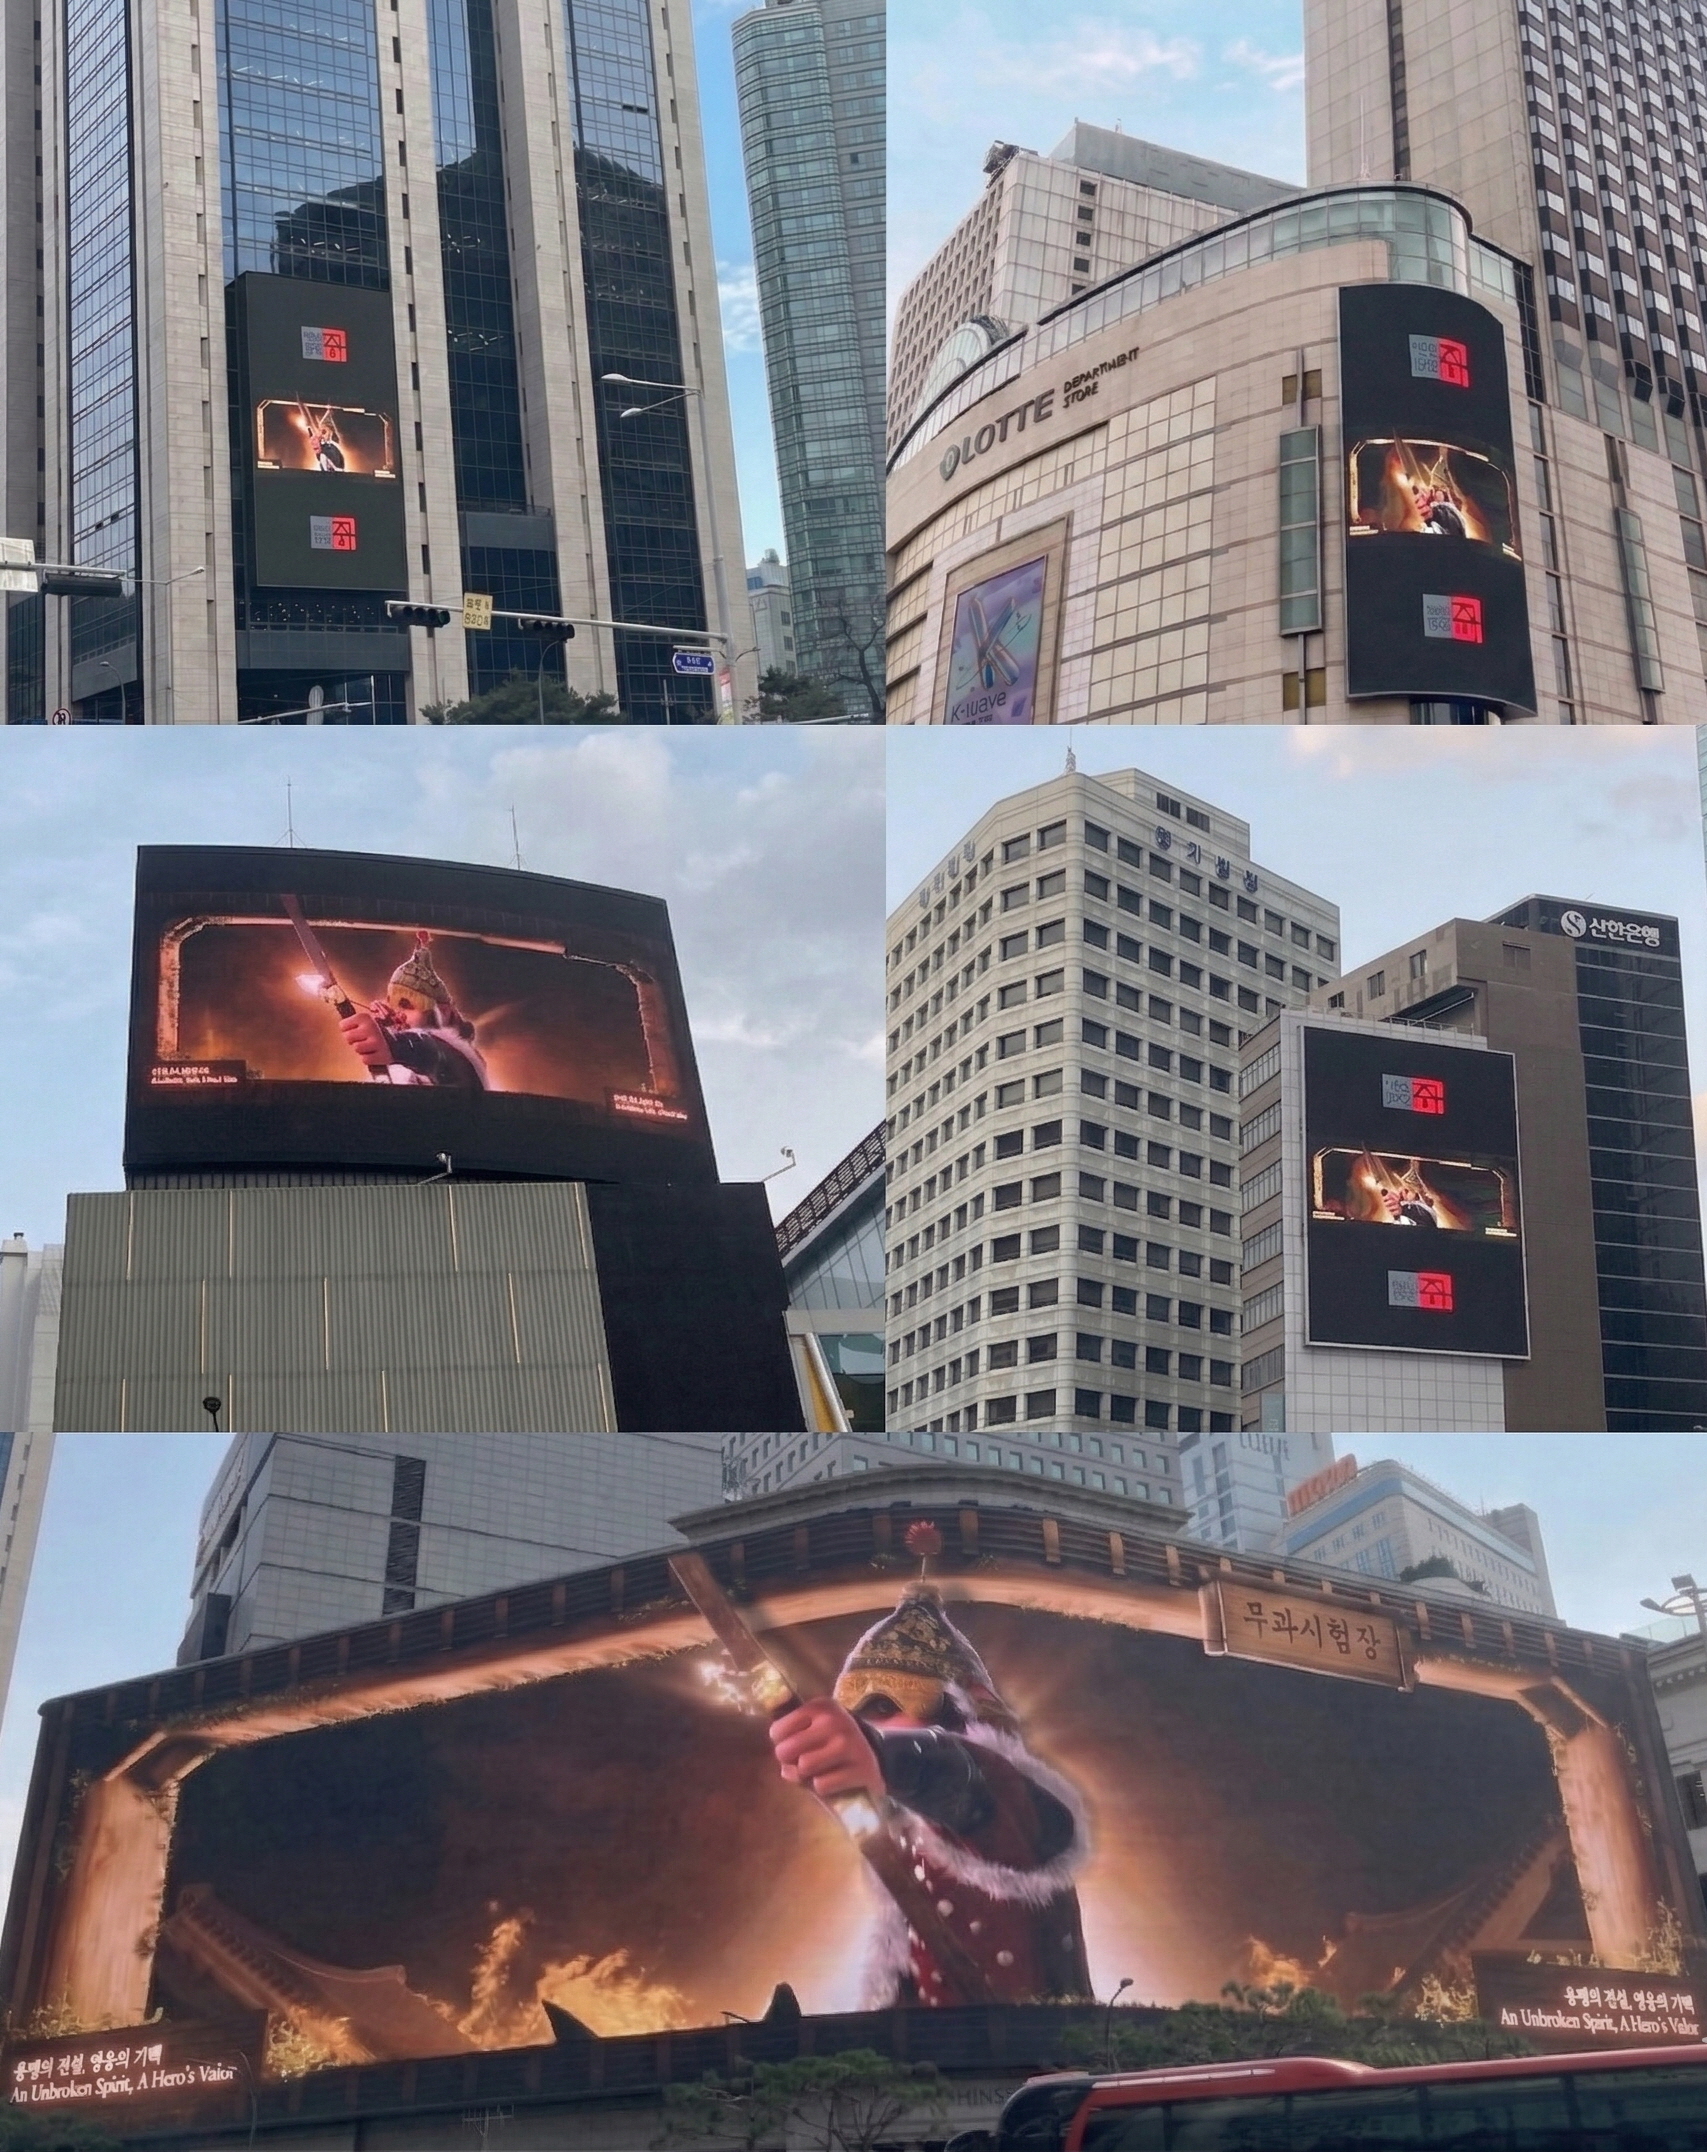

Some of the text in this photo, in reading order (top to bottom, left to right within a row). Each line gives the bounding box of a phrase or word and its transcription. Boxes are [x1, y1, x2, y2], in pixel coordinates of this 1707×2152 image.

[1063, 347, 1140, 394] DEPARTMENT
[1063, 382, 1099, 408] STORE
[961, 388, 1055, 465] LOTTE
[1589, 917, 1660, 948] 신한은행
[1243, 1601, 1381, 1660] 무과시험장
[1501, 2008, 1518, 2026] An
[1520, 2008, 1580, 2029] Unbroken
[10, 2086, 28, 2103] An
[32, 2080, 92, 2101] Unbroken
[136, 2072, 148, 2090] A
